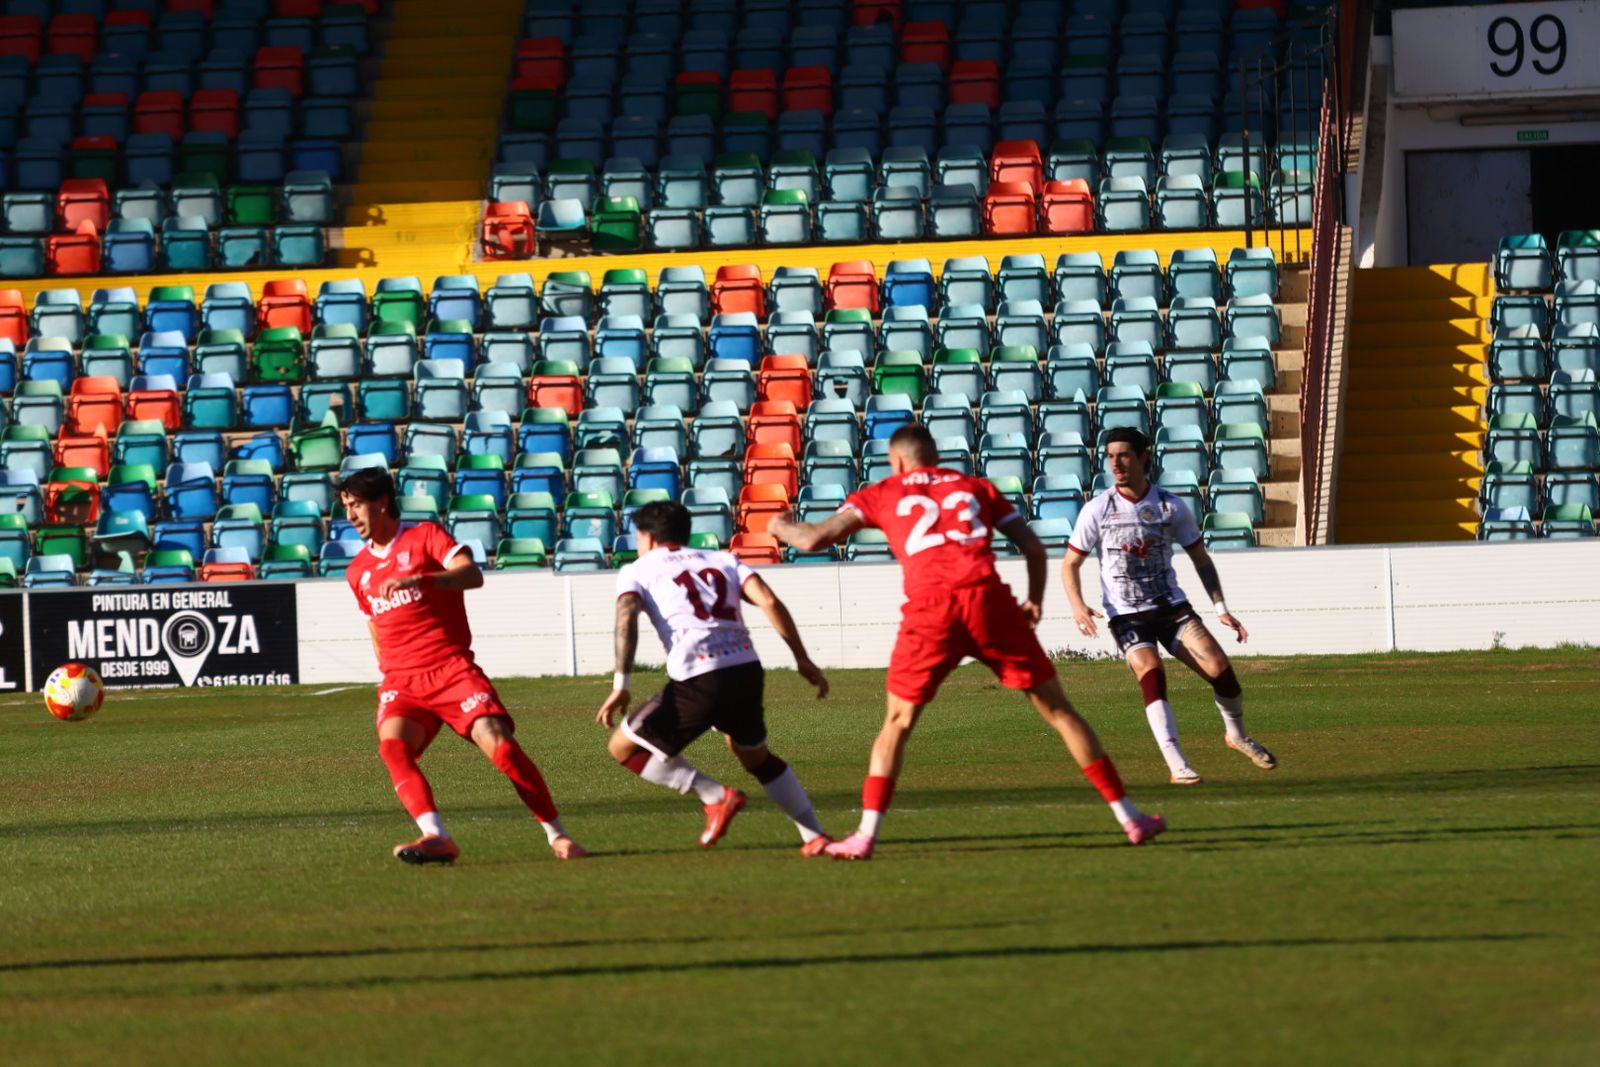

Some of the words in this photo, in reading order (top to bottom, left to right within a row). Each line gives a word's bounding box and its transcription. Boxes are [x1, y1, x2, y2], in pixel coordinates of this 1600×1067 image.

[1487, 14, 1567, 77] 99
[1518, 130, 1549, 140] SALIDA
[896, 490, 988, 557] 23
[92, 594, 149, 612] PINTURA
[152, 592, 170, 610] EN
[172, 590, 232, 609] GENERAL
[672, 567, 737, 621] 12
[101, 661, 139, 678] DESDE
[140, 660, 170, 677] 1999
